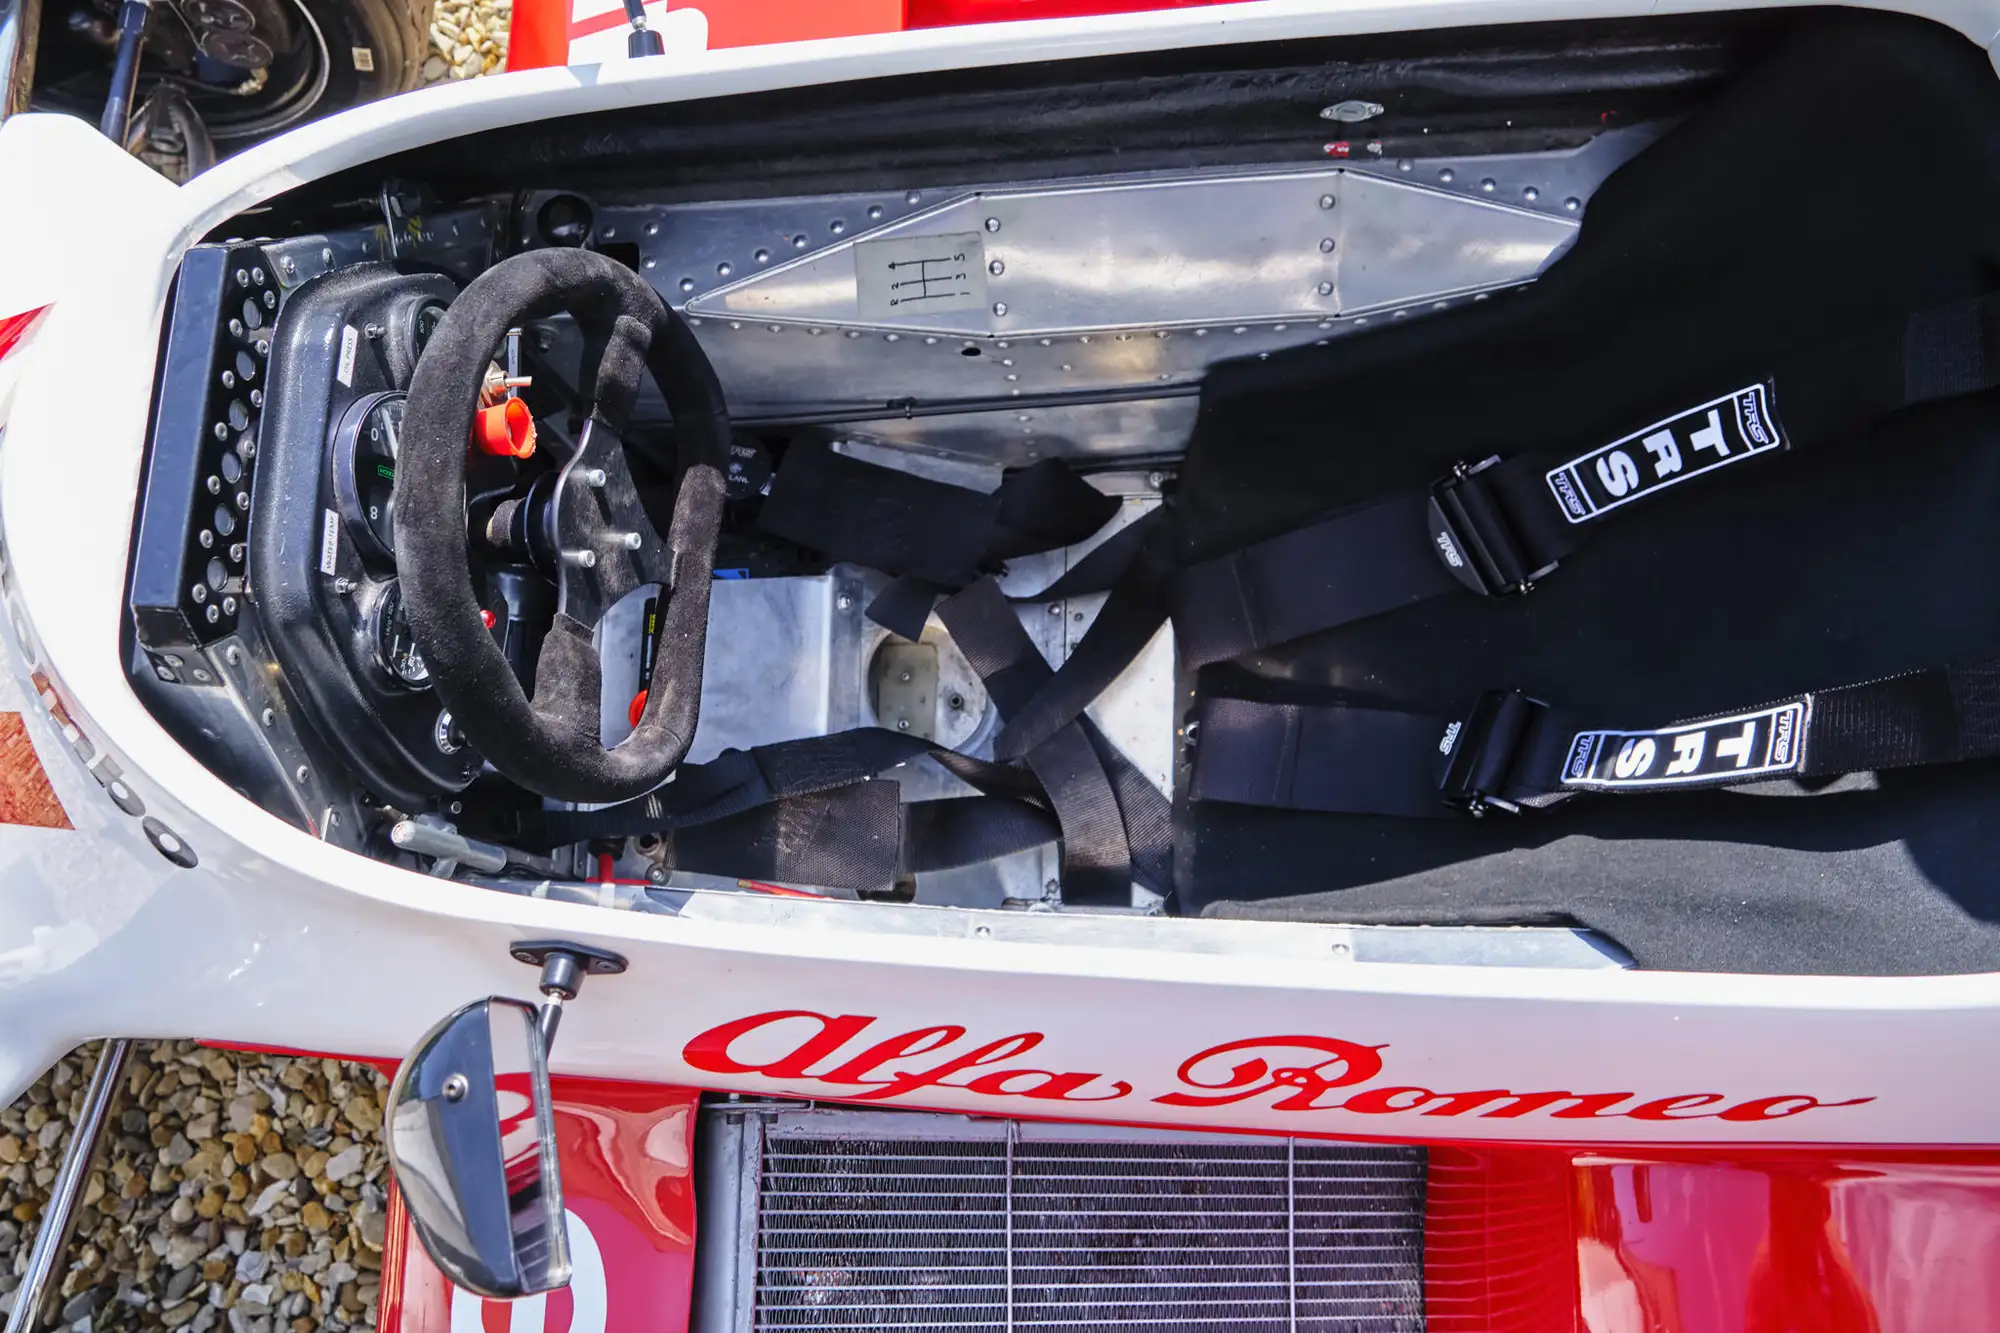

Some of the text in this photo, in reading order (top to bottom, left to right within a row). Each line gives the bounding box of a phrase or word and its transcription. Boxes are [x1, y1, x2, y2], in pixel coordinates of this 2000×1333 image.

[954, 252, 966, 261] 5
[955, 272, 966, 280] 3
[891, 282, 899, 290] 2
[1743, 391, 1769, 444] TRS
[1596, 408, 1731, 497] TRS
[1555, 472, 1586, 515] TRS
[1437, 531, 1463, 567] TRS
[1439, 721, 1462, 756] TRS
[1571, 734, 1595, 779] TRS
[1615, 721, 1757, 779] TRS
[1774, 709, 1794, 764] TRS
[682, 1009, 1878, 1121] Alfa Romeo
